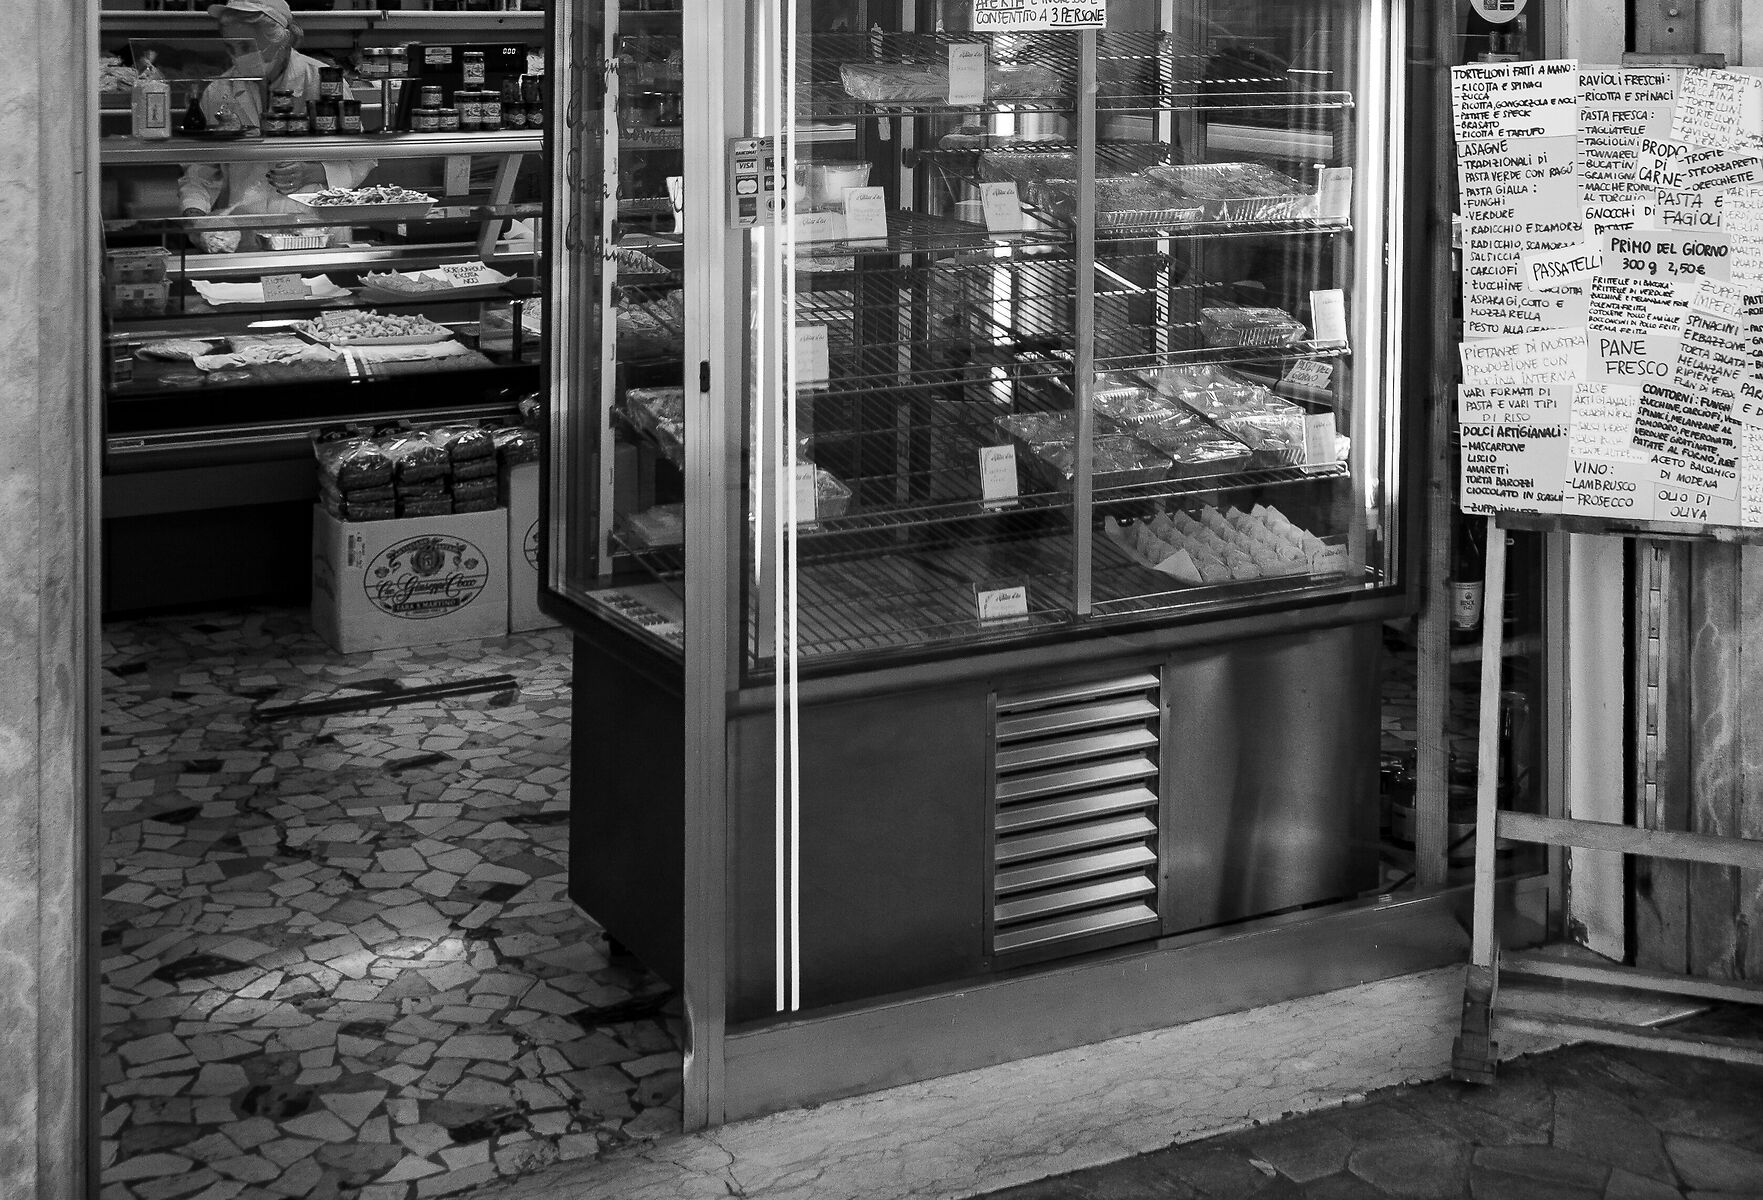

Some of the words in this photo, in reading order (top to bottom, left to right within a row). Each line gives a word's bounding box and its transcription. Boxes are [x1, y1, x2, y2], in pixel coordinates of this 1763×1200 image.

[976, 9, 1037, 24] CONSENTITO
[1039, 8, 1047, 22] A
[1051, 7, 1059, 22] 3
[1061, 7, 1105, 22] PERSONE
[1453, 65, 1509, 79] TORTELLONI
[1513, 64, 1534, 76] FATTI
[1538, 66, 1545, 75] A
[1580, 72, 1622, 86] RAVIOLI
[1511, 81, 1542, 91] SPINACI
[1558, 96, 1577, 105] NOCI
[1625, 92, 1632, 101] E
[1635, 90, 1673, 101] SPINACI
[1503, 110, 1531, 118] SPECK
[1581, 110, 1609, 121] PASTA
[1506, 128, 1545, 137] TARTUFO
[1458, 140, 1508, 158] LASAGNE
[1538, 152, 1547, 164] DI
[1655, 159, 1667, 171] DI
[1465, 172, 1489, 182] PASTA
[1491, 171, 1521, 182] VERDE
[1526, 169, 1544, 178] CON
[1639, 167, 1683, 188] CARNE
[1657, 190, 1703, 208] PASTA
[1714, 196, 1723, 207] E
[1586, 205, 1635, 219] GNOCCHI
[1645, 205, 1656, 216] DI
[1663, 210, 1722, 227] FAGIOLI
[1471, 224, 1523, 235] RADICCHIO
[1526, 223, 1533, 233] E
[1611, 237, 1651, 254] PRIMO
[1657, 242, 1677, 255] DEL
[1682, 239, 1729, 257] GIORNO
[1470, 252, 1520, 261] SALSICCIA
[1470, 262, 1517, 275] CARCIOFI
[1533, 249, 1603, 281] PASSATELLI
[1622, 257, 1645, 270] 300
[1648, 261, 1657, 275] g
[1472, 279, 1523, 291] ZUCCHINE
[1593, 276, 1630, 285] FRITTELLE
[1557, 300, 1564, 308] E
[1471, 308, 1541, 321] MOZZARELLA
[1503, 325, 1524, 334] ALLA
[1589, 324, 1616, 333] CREMA
[1687, 315, 1739, 336] SPINACINI
[1684, 329, 1745, 351] ERBAZZONE
[1465, 344, 1519, 360] PIETANZE
[1526, 338, 1536, 353] DI
[1600, 338, 1647, 358] PANE
[1680, 343, 1710, 359] TORTA
[1605, 360, 1669, 377] FRESCO
[1676, 367, 1719, 384] RIPIENE
[1463, 387, 1485, 397] VARI
[1490, 387, 1534, 396] FORMATI
[1539, 388, 1551, 396] DI
[1466, 400, 1493, 411] PASTA
[1497, 400, 1505, 408] E
[1508, 400, 1529, 409] VARI
[1534, 400, 1557, 408] TIPI
[1483, 413, 1496, 422] DI
[1504, 413, 1530, 422] RISO
[1463, 425, 1494, 437] DOLCI
[1632, 436, 1664, 451] PATATE
[1467, 454, 1497, 463] LISCIO
[1466, 464, 1509, 475] AMARETTI
[1651, 455, 1685, 468] ACETO
[1690, 461, 1736, 479] BALSAMICO
[1466, 475, 1492, 485] TORTA
[1496, 478, 1534, 487] BAROZZI
[1661, 470, 1670, 479] DI
[1677, 473, 1718, 489] MODENA
[1466, 487, 1519, 498] CIOCCOLATO
[1523, 491, 1533, 500] IN
[1659, 491, 1688, 502] OLIO
[1697, 493, 1711, 506] DI
[1670, 506, 1707, 520] OLIVA
